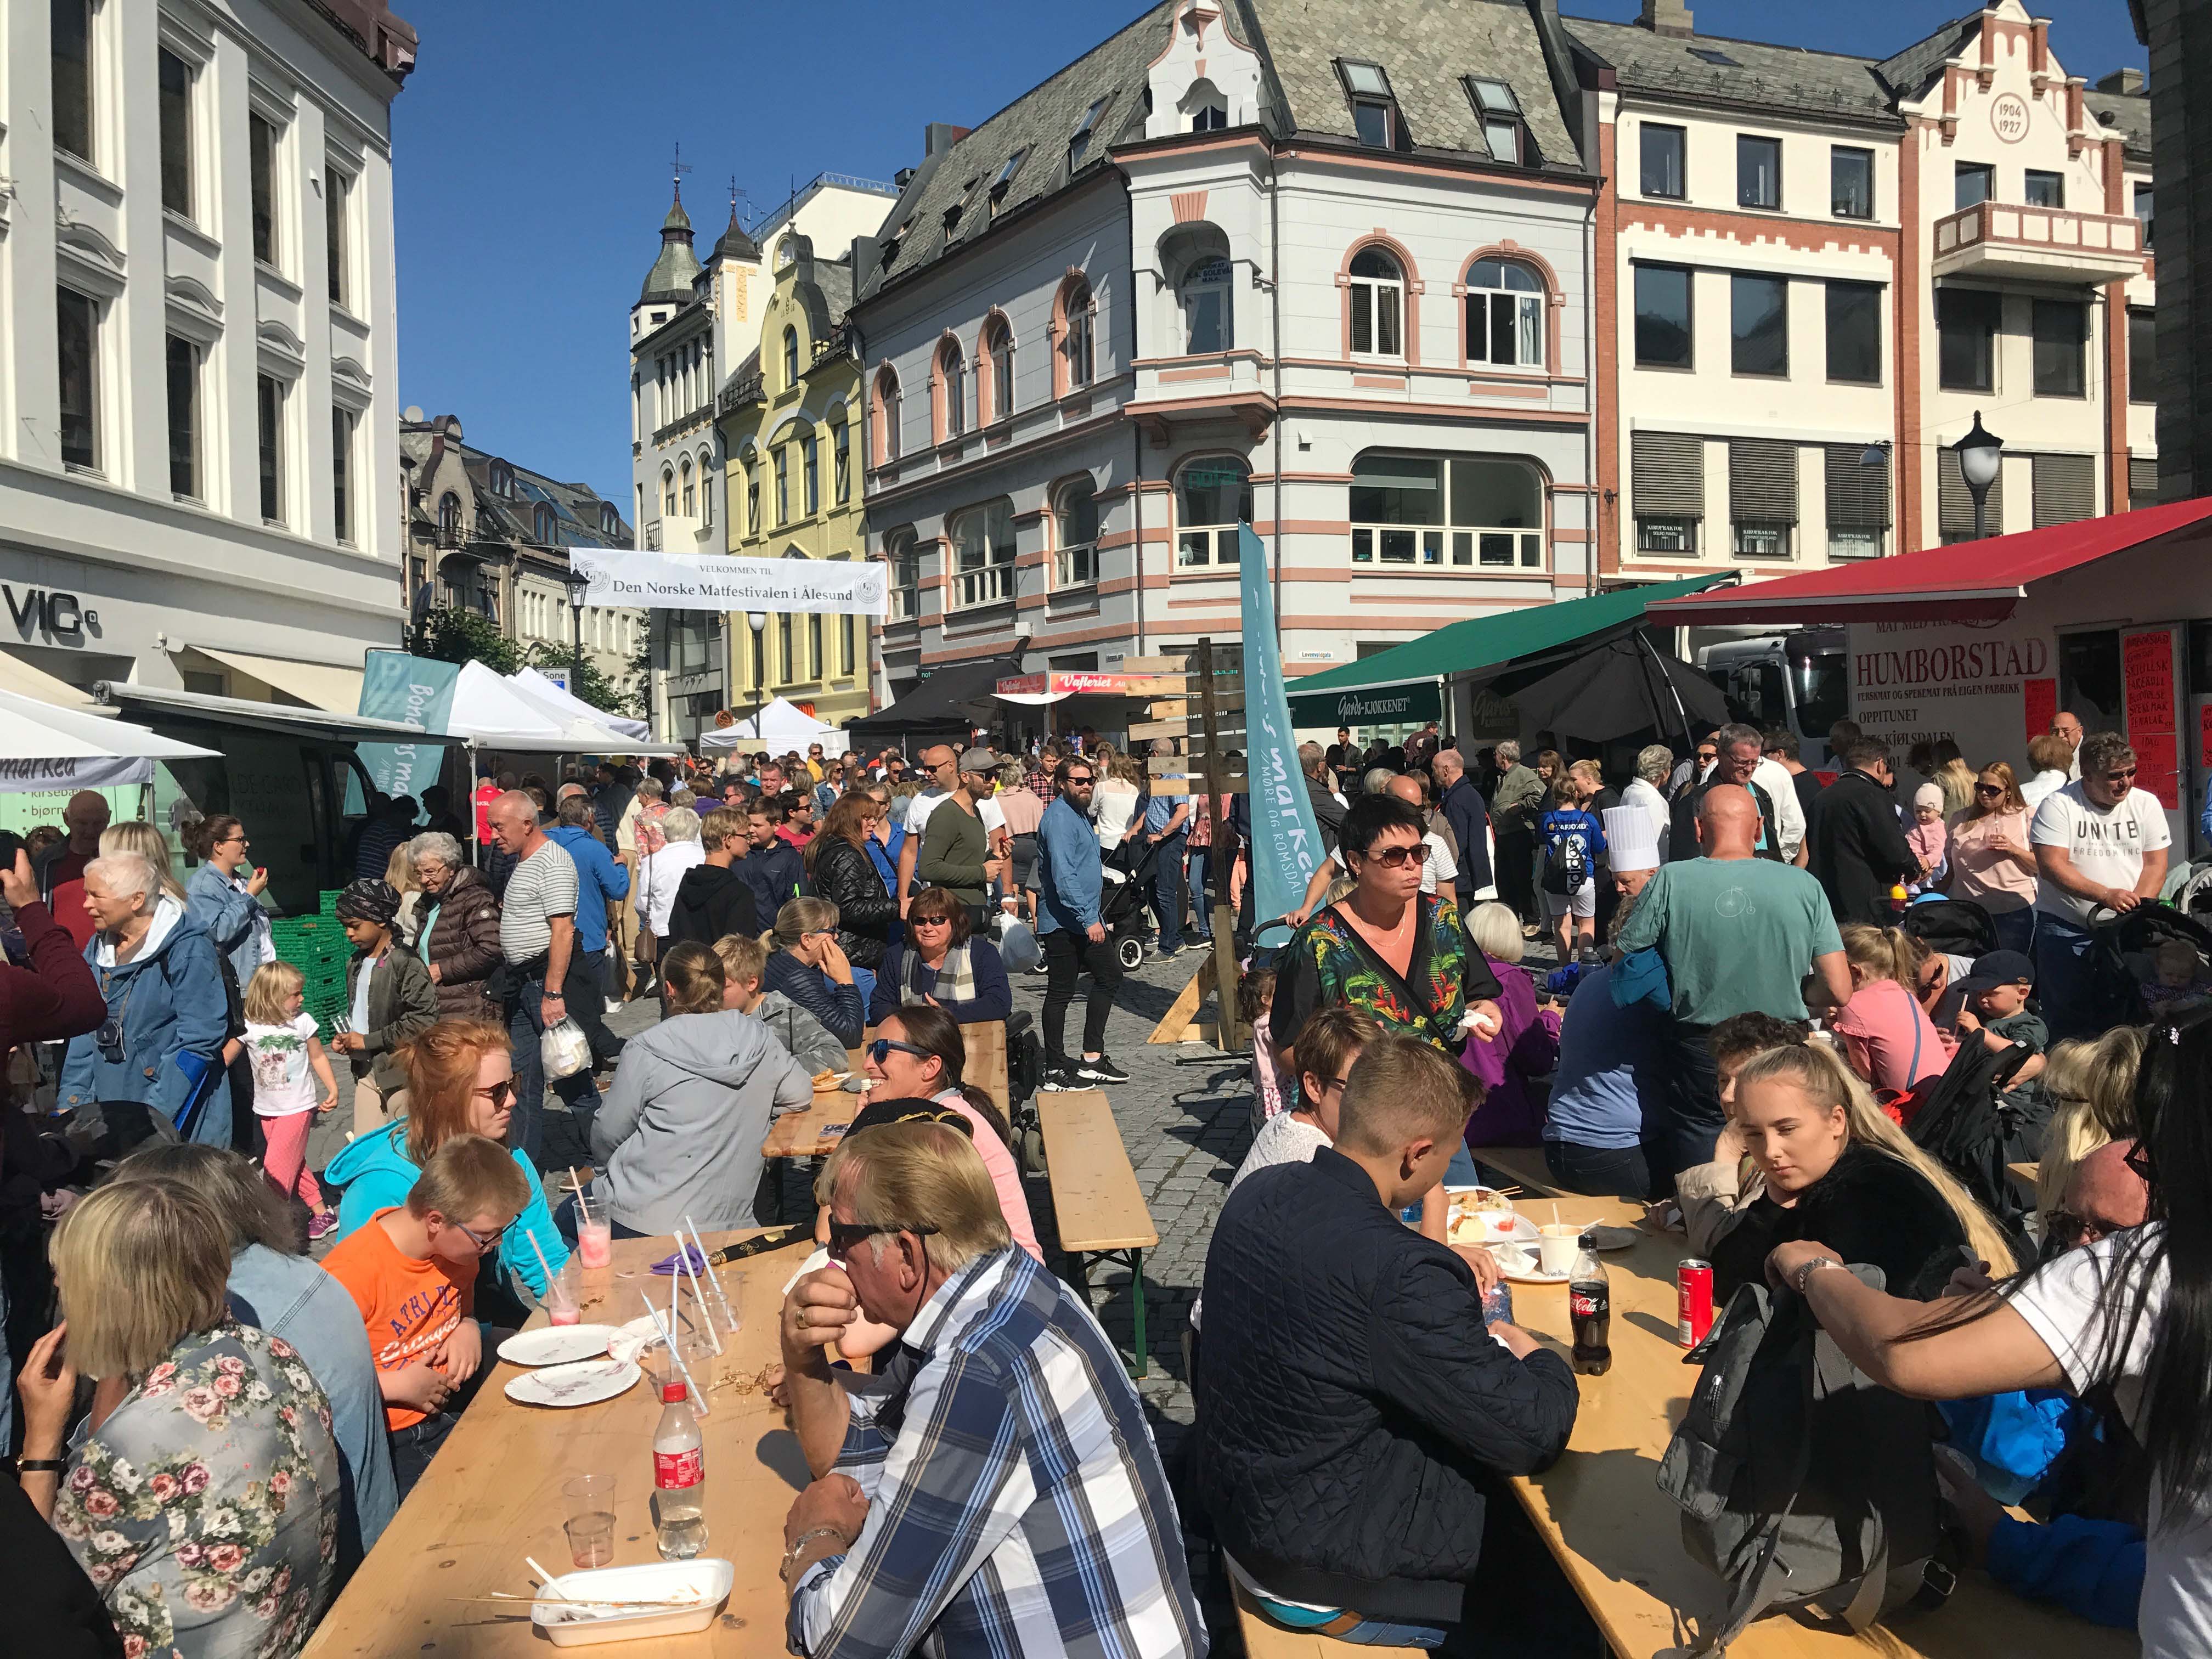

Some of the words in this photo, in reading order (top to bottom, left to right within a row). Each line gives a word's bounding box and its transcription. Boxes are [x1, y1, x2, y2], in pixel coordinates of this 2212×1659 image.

[1999, 103, 2021, 117] 1904
[1999, 120, 2021, 133] 1927
[699, 565, 757, 574] VELKOMMEN
[613, 580, 642, 593] Den
[646, 582, 695, 595] Norske
[699, 583, 789, 599] Matfestivalen
[793, 588, 797, 599] i
[802, 584, 853, 601] Ålesund
[1857, 637, 2047, 686] HUMBORSTAD
[1059, 675, 1112, 689] Vafleriet
[1858, 691, 1891, 702] FERSKMAT
[1893, 690, 1903, 699] OG
[1905, 687, 1940, 699] SPEKEMAT
[1943, 684, 1957, 697] FRÅ
[1959, 685, 1982, 696] EIGEN
[1984, 684, 2019, 695] FABRIKK
[1859, 709, 1918, 724] OPPITUNET
[1268, 810, 1280, 828] OG
[2078, 820, 2137, 840] UNITE
[2073, 847, 2120, 857] FREEDOM
[1273, 833, 1304, 897] ROMSDAL
